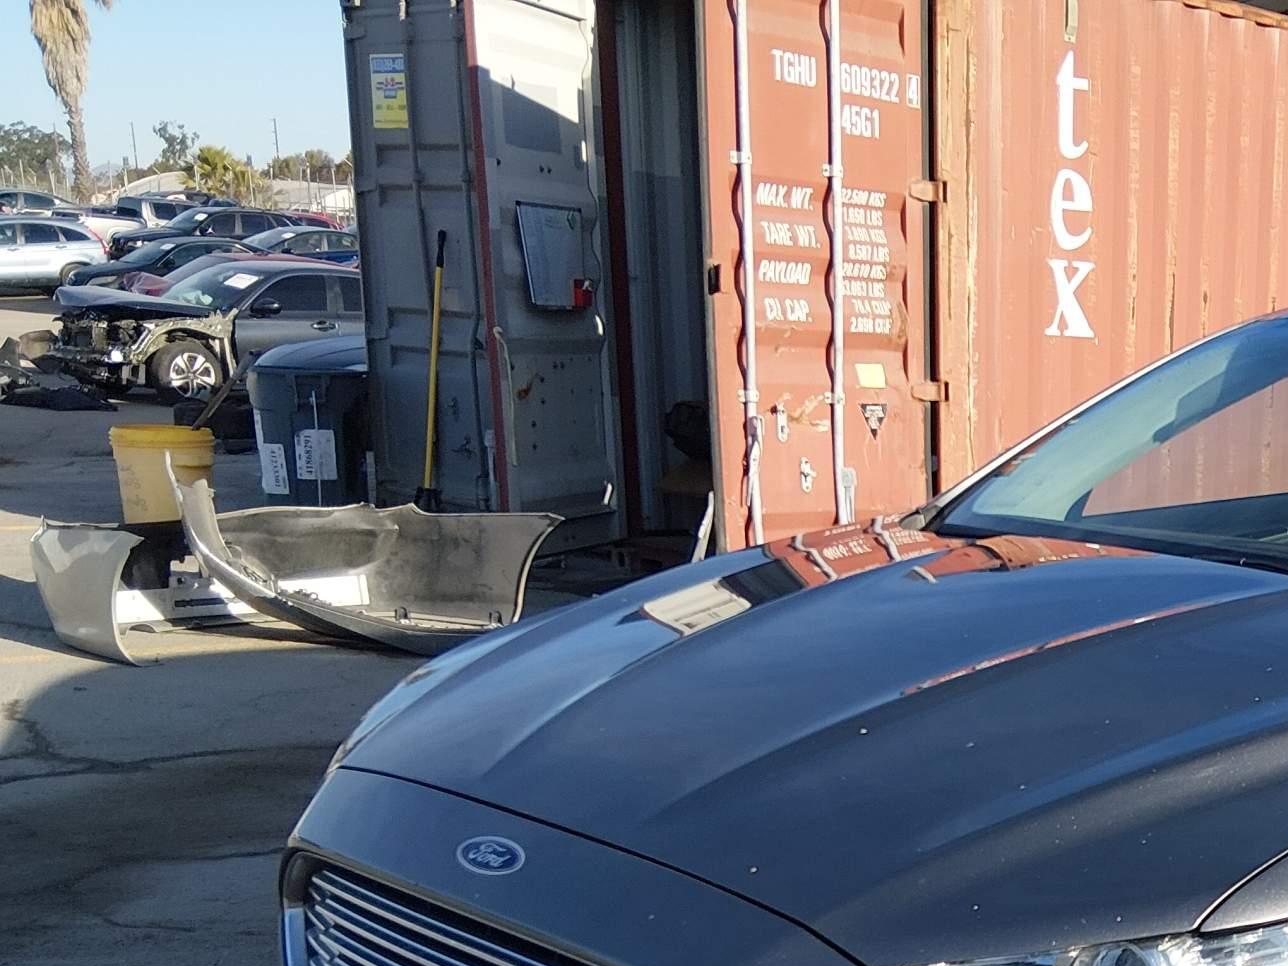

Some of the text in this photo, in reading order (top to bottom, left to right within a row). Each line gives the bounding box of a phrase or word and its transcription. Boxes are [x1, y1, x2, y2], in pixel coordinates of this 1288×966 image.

[771, 48, 919, 106] TGHU 609322 4
[841, 104, 880, 139] 45G1
[756, 182, 788, 208] MAX.
[790, 186, 814, 211] WT.
[1045, 49, 1096, 339] tex
[761, 221, 793, 246] TARE
[794, 224, 821, 249] WT.
[758, 259, 812, 285] PAYLOAD
[785, 299, 812, 323] CAP.
[468, 842, 512, 867] Ford
